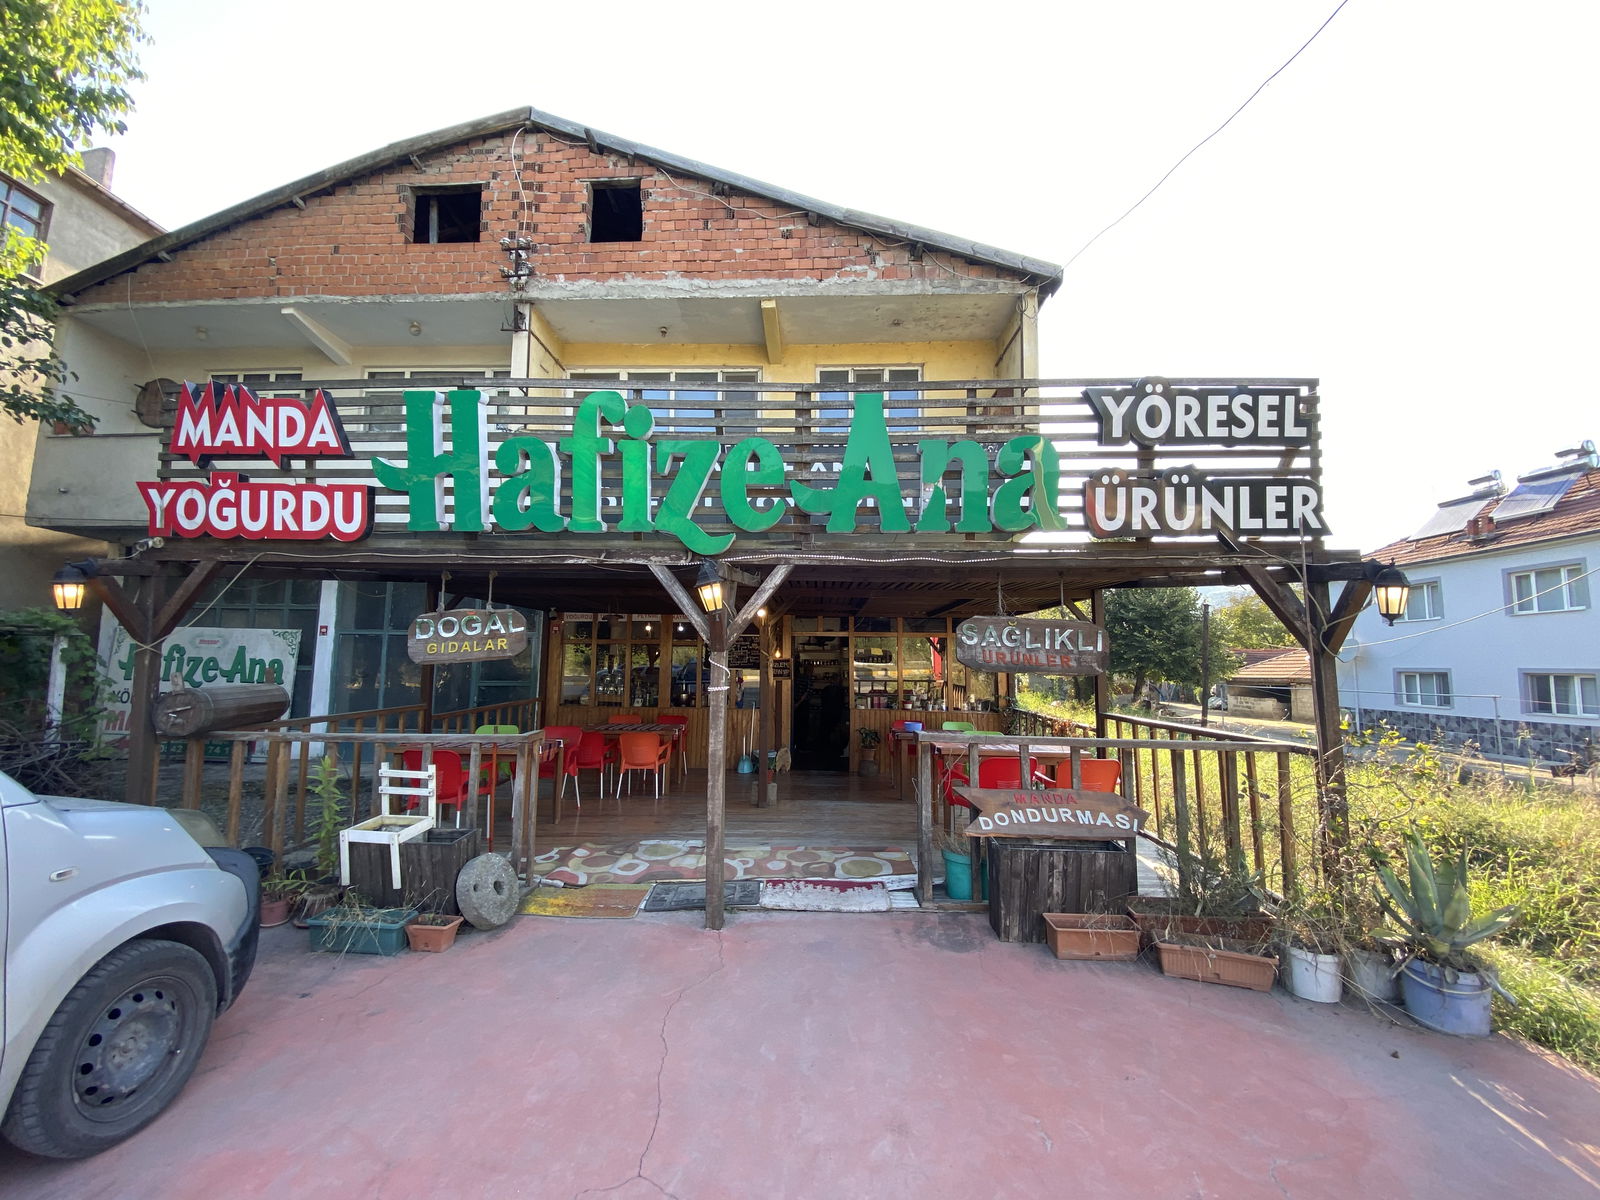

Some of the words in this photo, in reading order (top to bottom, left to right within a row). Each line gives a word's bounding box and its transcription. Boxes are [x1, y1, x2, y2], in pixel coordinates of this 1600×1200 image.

[176, 404, 341, 450] MANDA
[1101, 383, 1308, 439] YÖRESEL
[372, 389, 786, 556] Hafize
[790, 392, 1068, 533] Ana
[146, 481, 364, 534] YOĞURDU
[1094, 474, 1323, 532] ÜRÜNLER
[415, 611, 525, 640] DOĞAL
[961, 621, 1103, 652] SAĞLIKLI
[426, 638, 508, 654] GIDALAR
[1013, 793, 1078, 805] MANDA
[978, 807, 1139, 832] DONDURMASI
